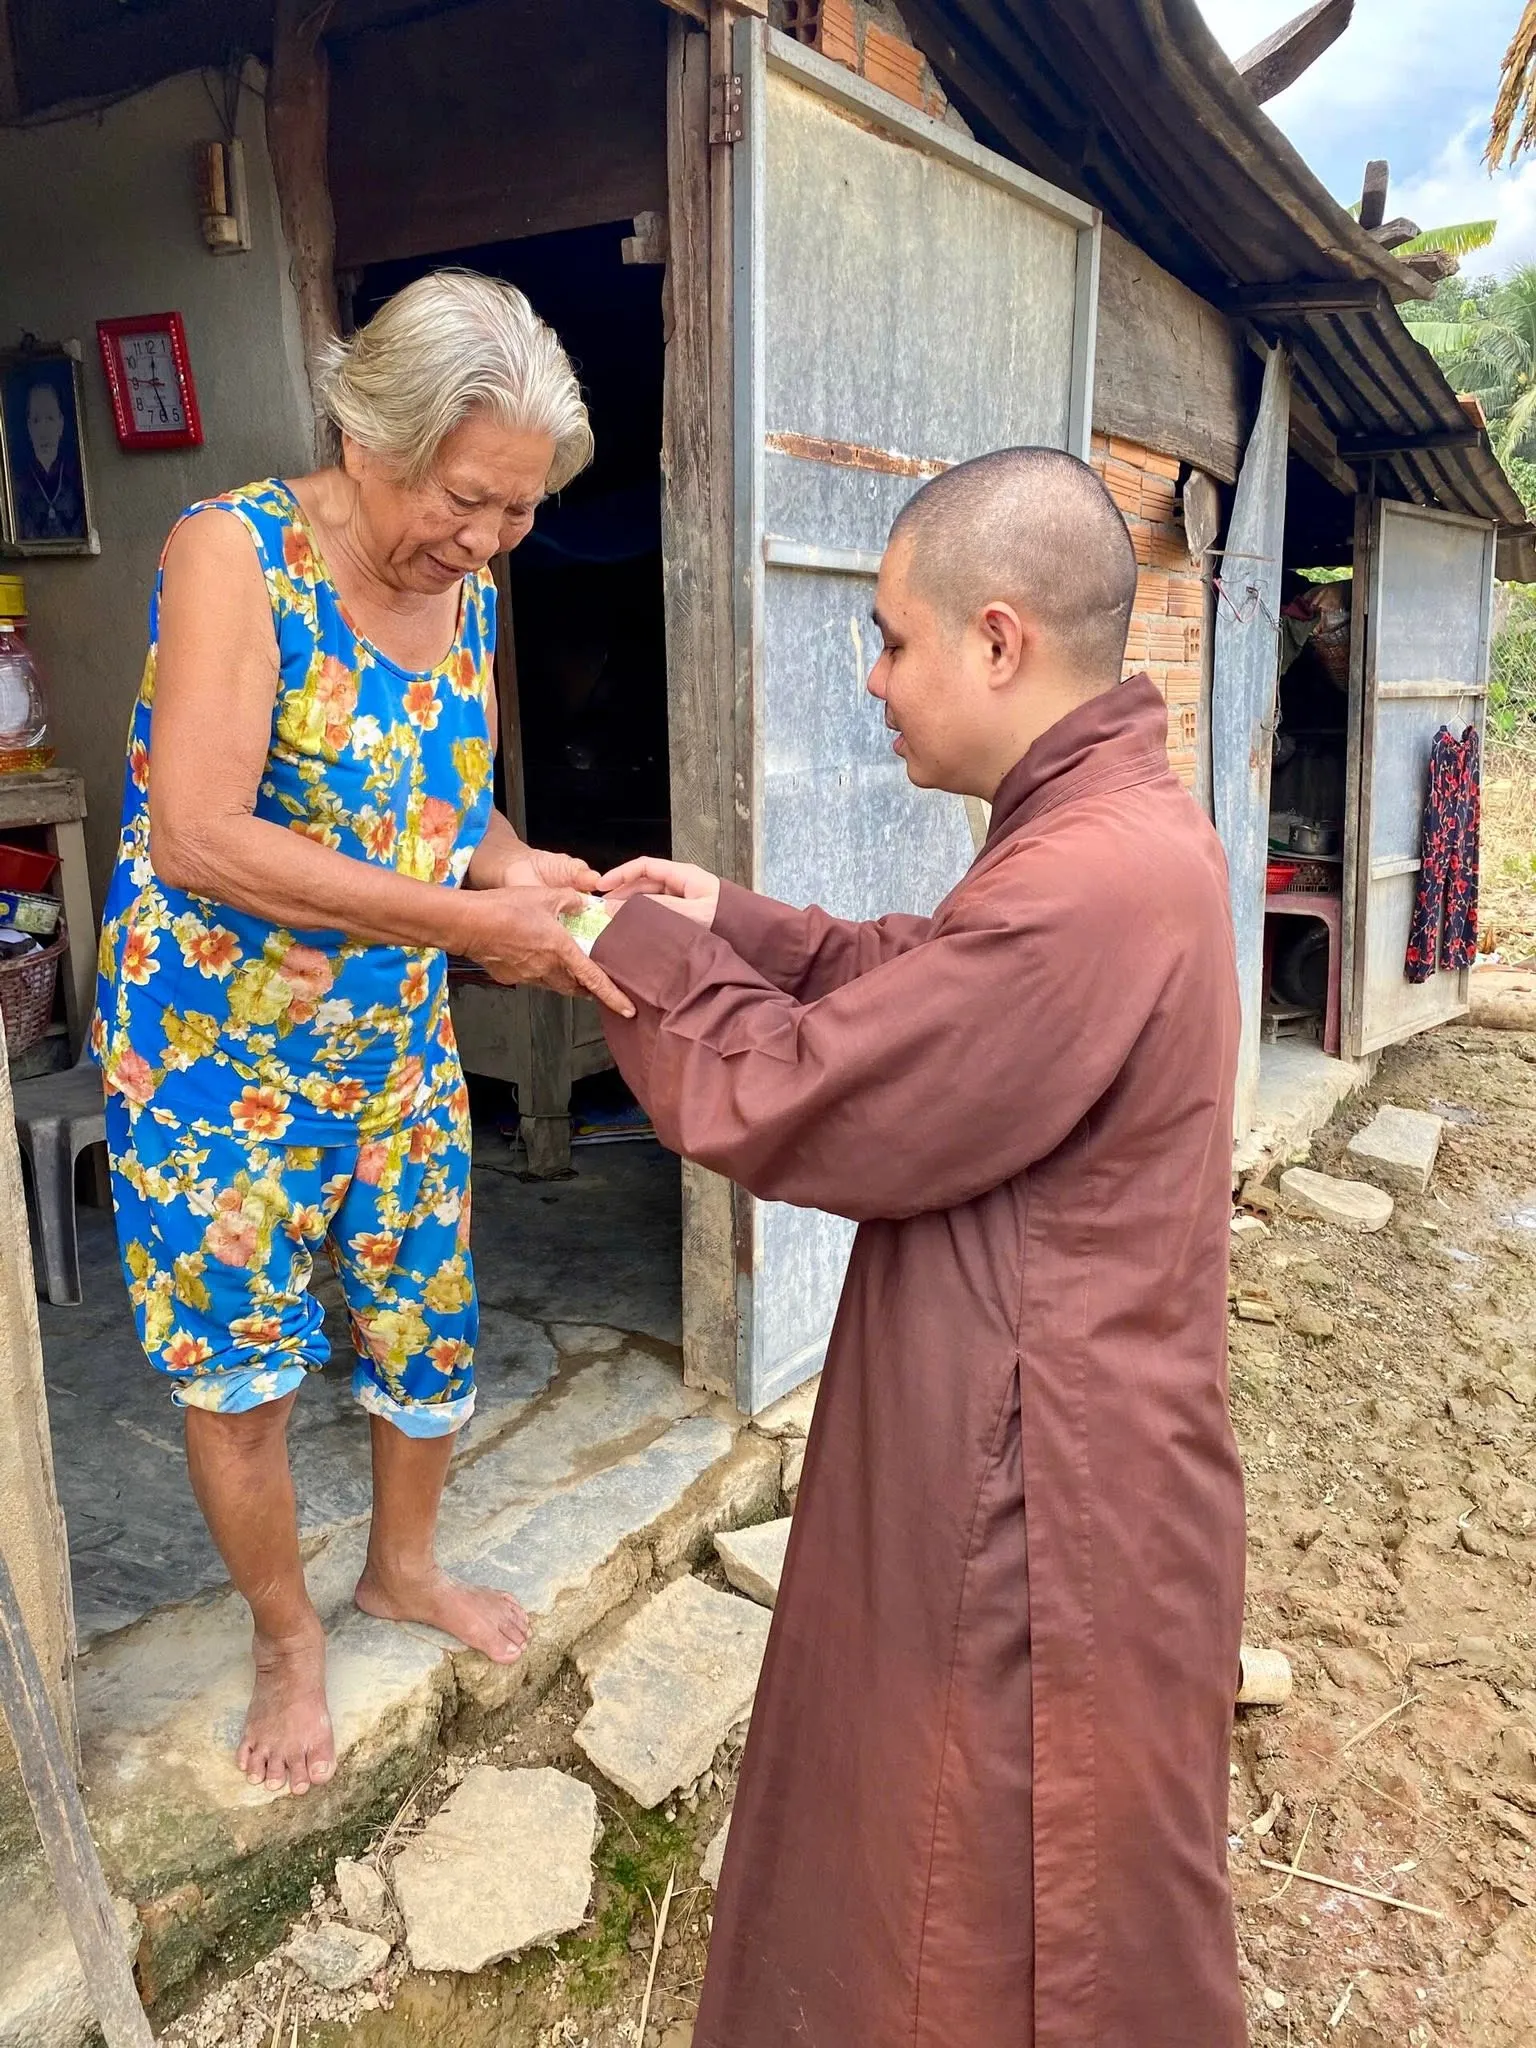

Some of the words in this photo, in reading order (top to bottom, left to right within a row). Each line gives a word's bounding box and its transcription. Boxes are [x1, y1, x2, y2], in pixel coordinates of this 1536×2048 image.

[134, 342, 142, 355] 11
[145, 340, 156, 354] 12
[126, 356, 136, 370] 10
[132, 377, 140, 391] 9
[136, 397, 144, 412] 8
[147, 410, 154, 424] 7
[159, 409, 168, 423] 6
[172, 408, 180, 422] 5
